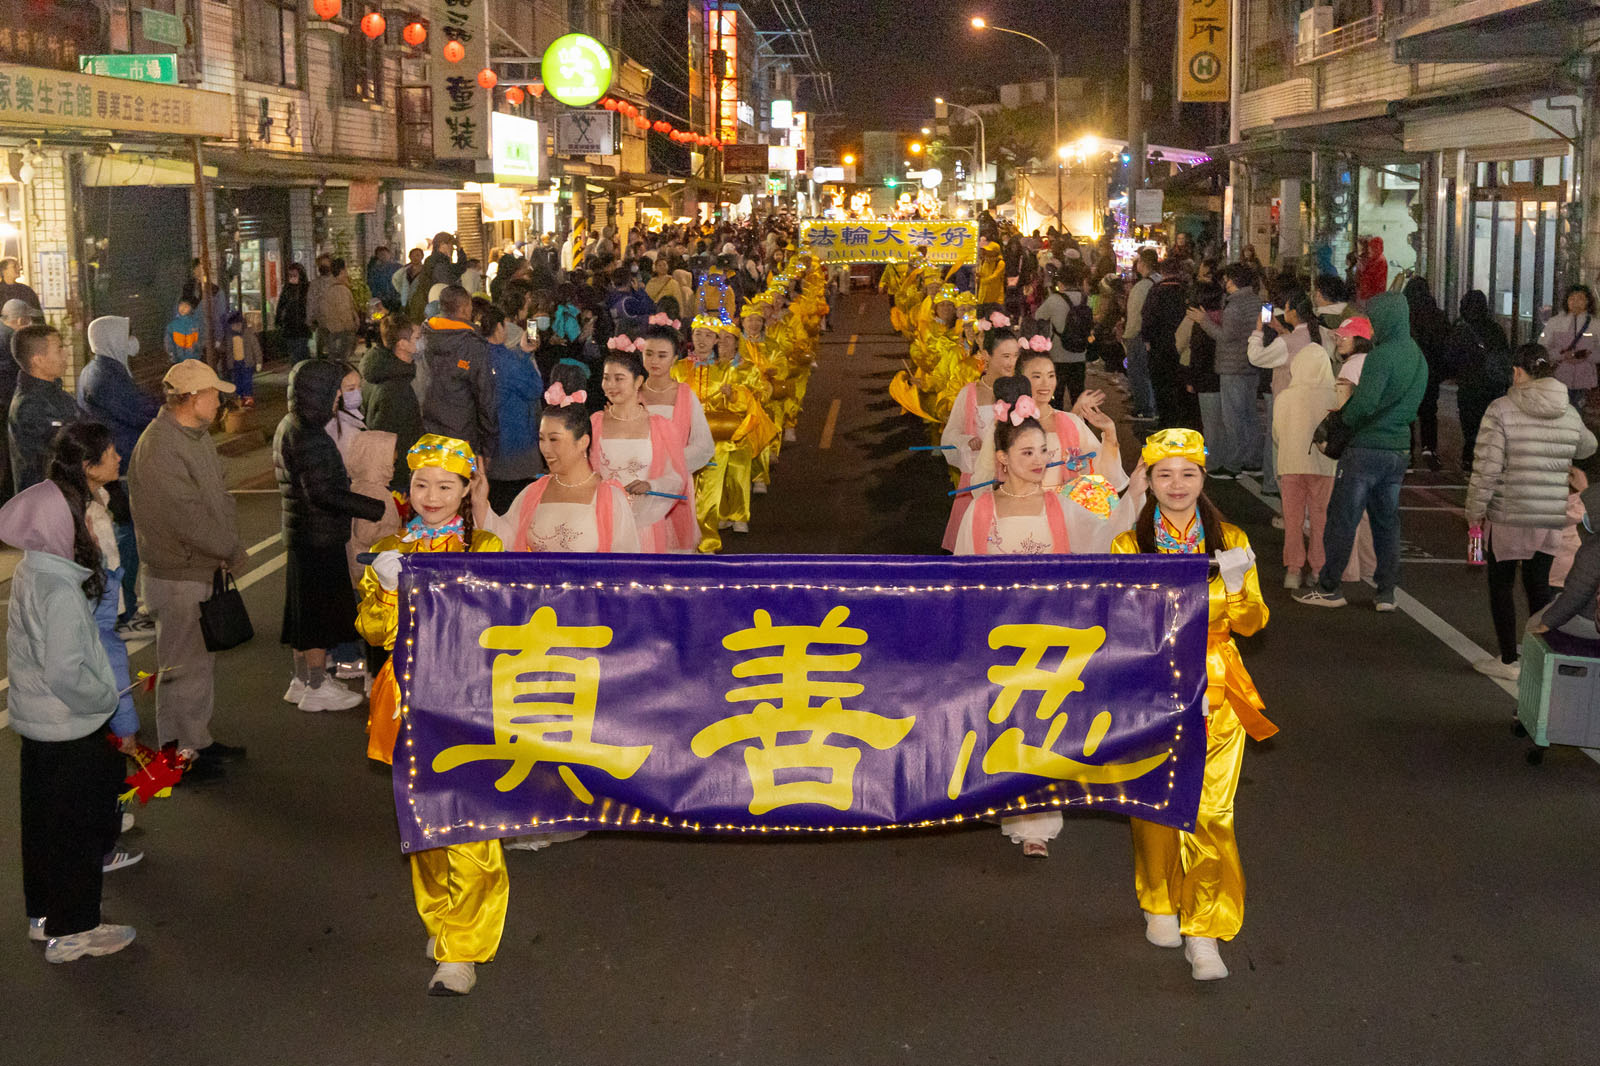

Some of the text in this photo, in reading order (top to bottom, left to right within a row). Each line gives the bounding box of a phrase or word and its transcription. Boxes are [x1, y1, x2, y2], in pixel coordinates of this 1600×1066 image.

[94, 59, 161, 80] 第一市場
[807, 225, 973, 248] 法輪大法好
[432, 604, 1172, 816] 真善忍
